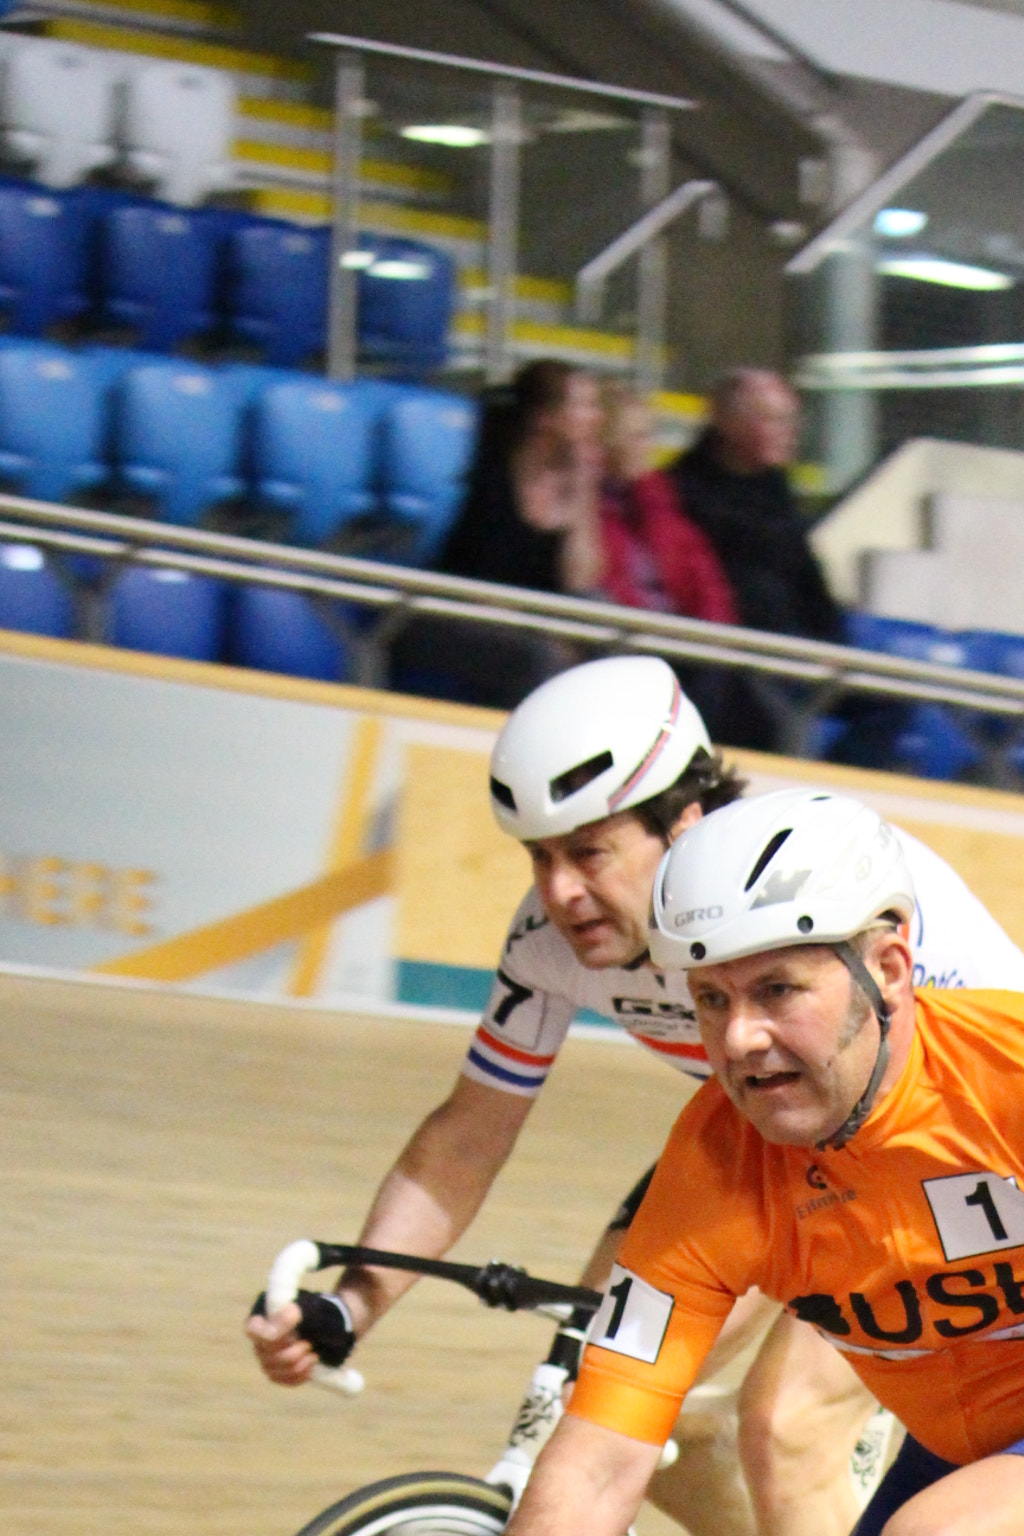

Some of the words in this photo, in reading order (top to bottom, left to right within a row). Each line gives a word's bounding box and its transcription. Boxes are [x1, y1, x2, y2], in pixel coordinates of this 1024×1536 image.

[674, 905, 724, 928] GIRO
[493, 968, 533, 1026] 7
[965, 1181, 1009, 1240] 1
[604, 1276, 633, 1340] 1
